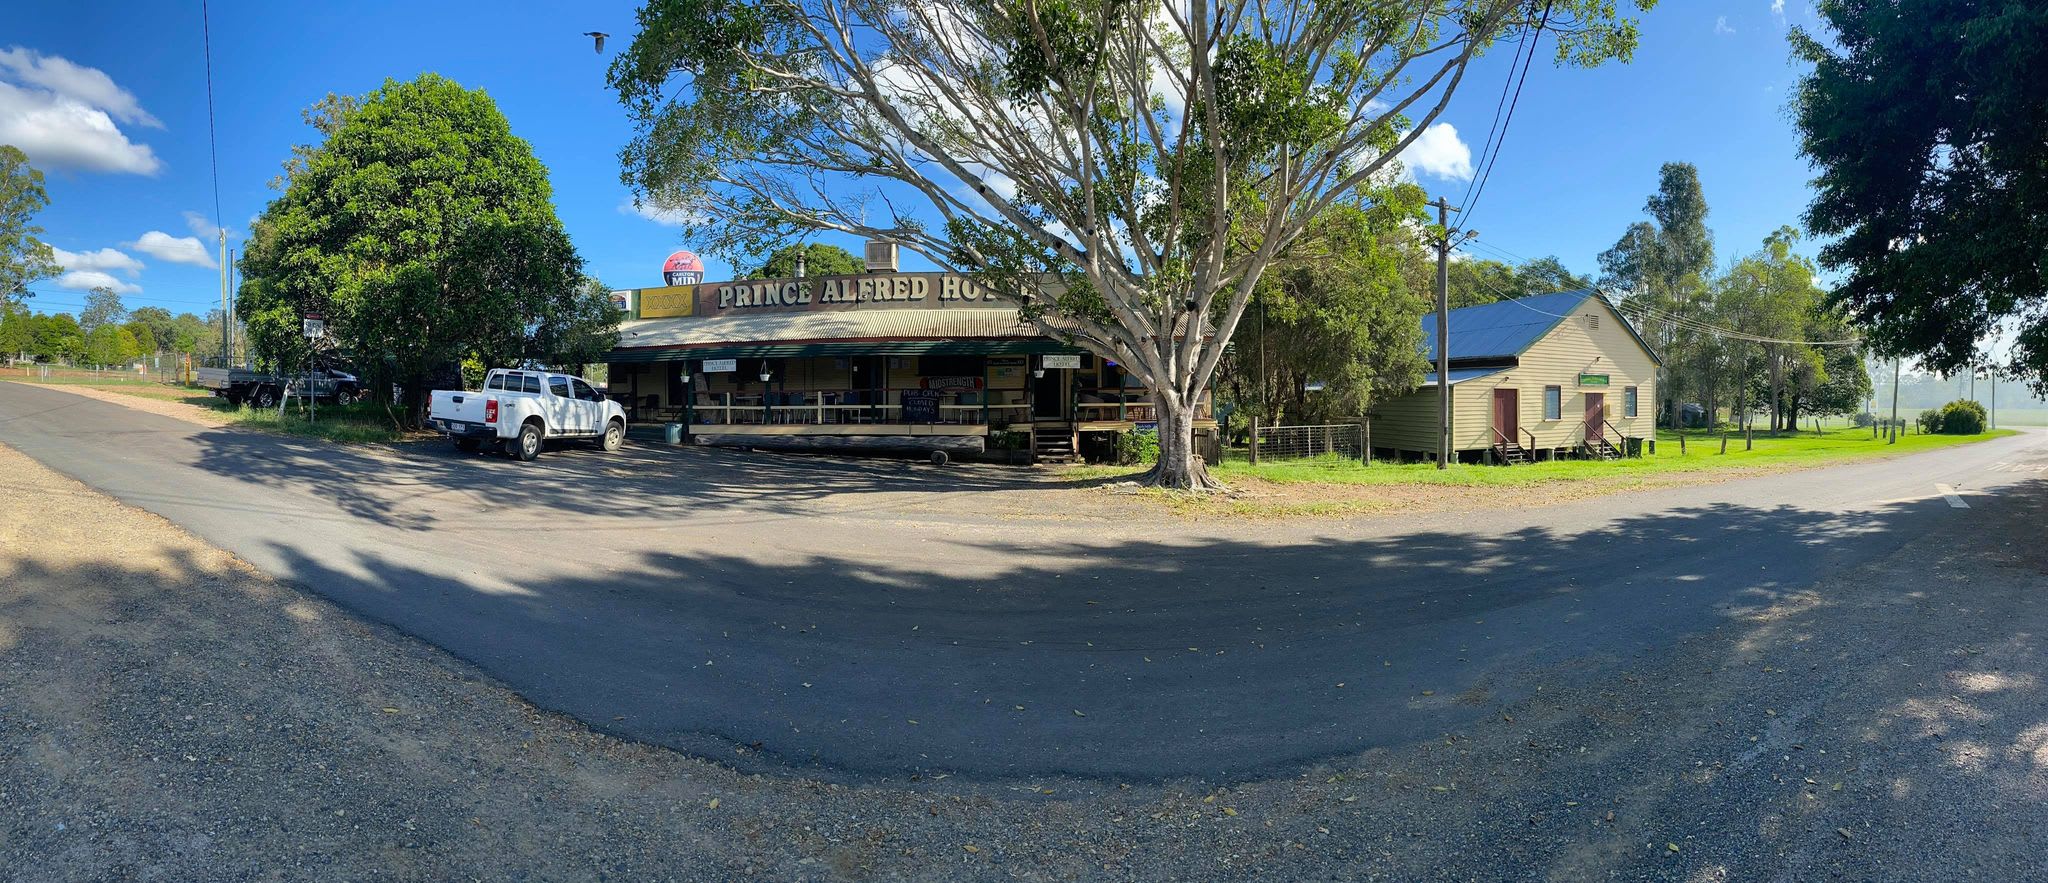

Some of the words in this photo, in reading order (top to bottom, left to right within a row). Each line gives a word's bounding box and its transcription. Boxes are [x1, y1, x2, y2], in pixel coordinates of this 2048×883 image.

[672, 277, 696, 286] MID
[719, 281, 813, 308] PRINCE
[821, 276, 930, 301] ALFRED
[646, 293, 688, 310] XXXX
[928, 375, 975, 390] MIDSTRENGTH
